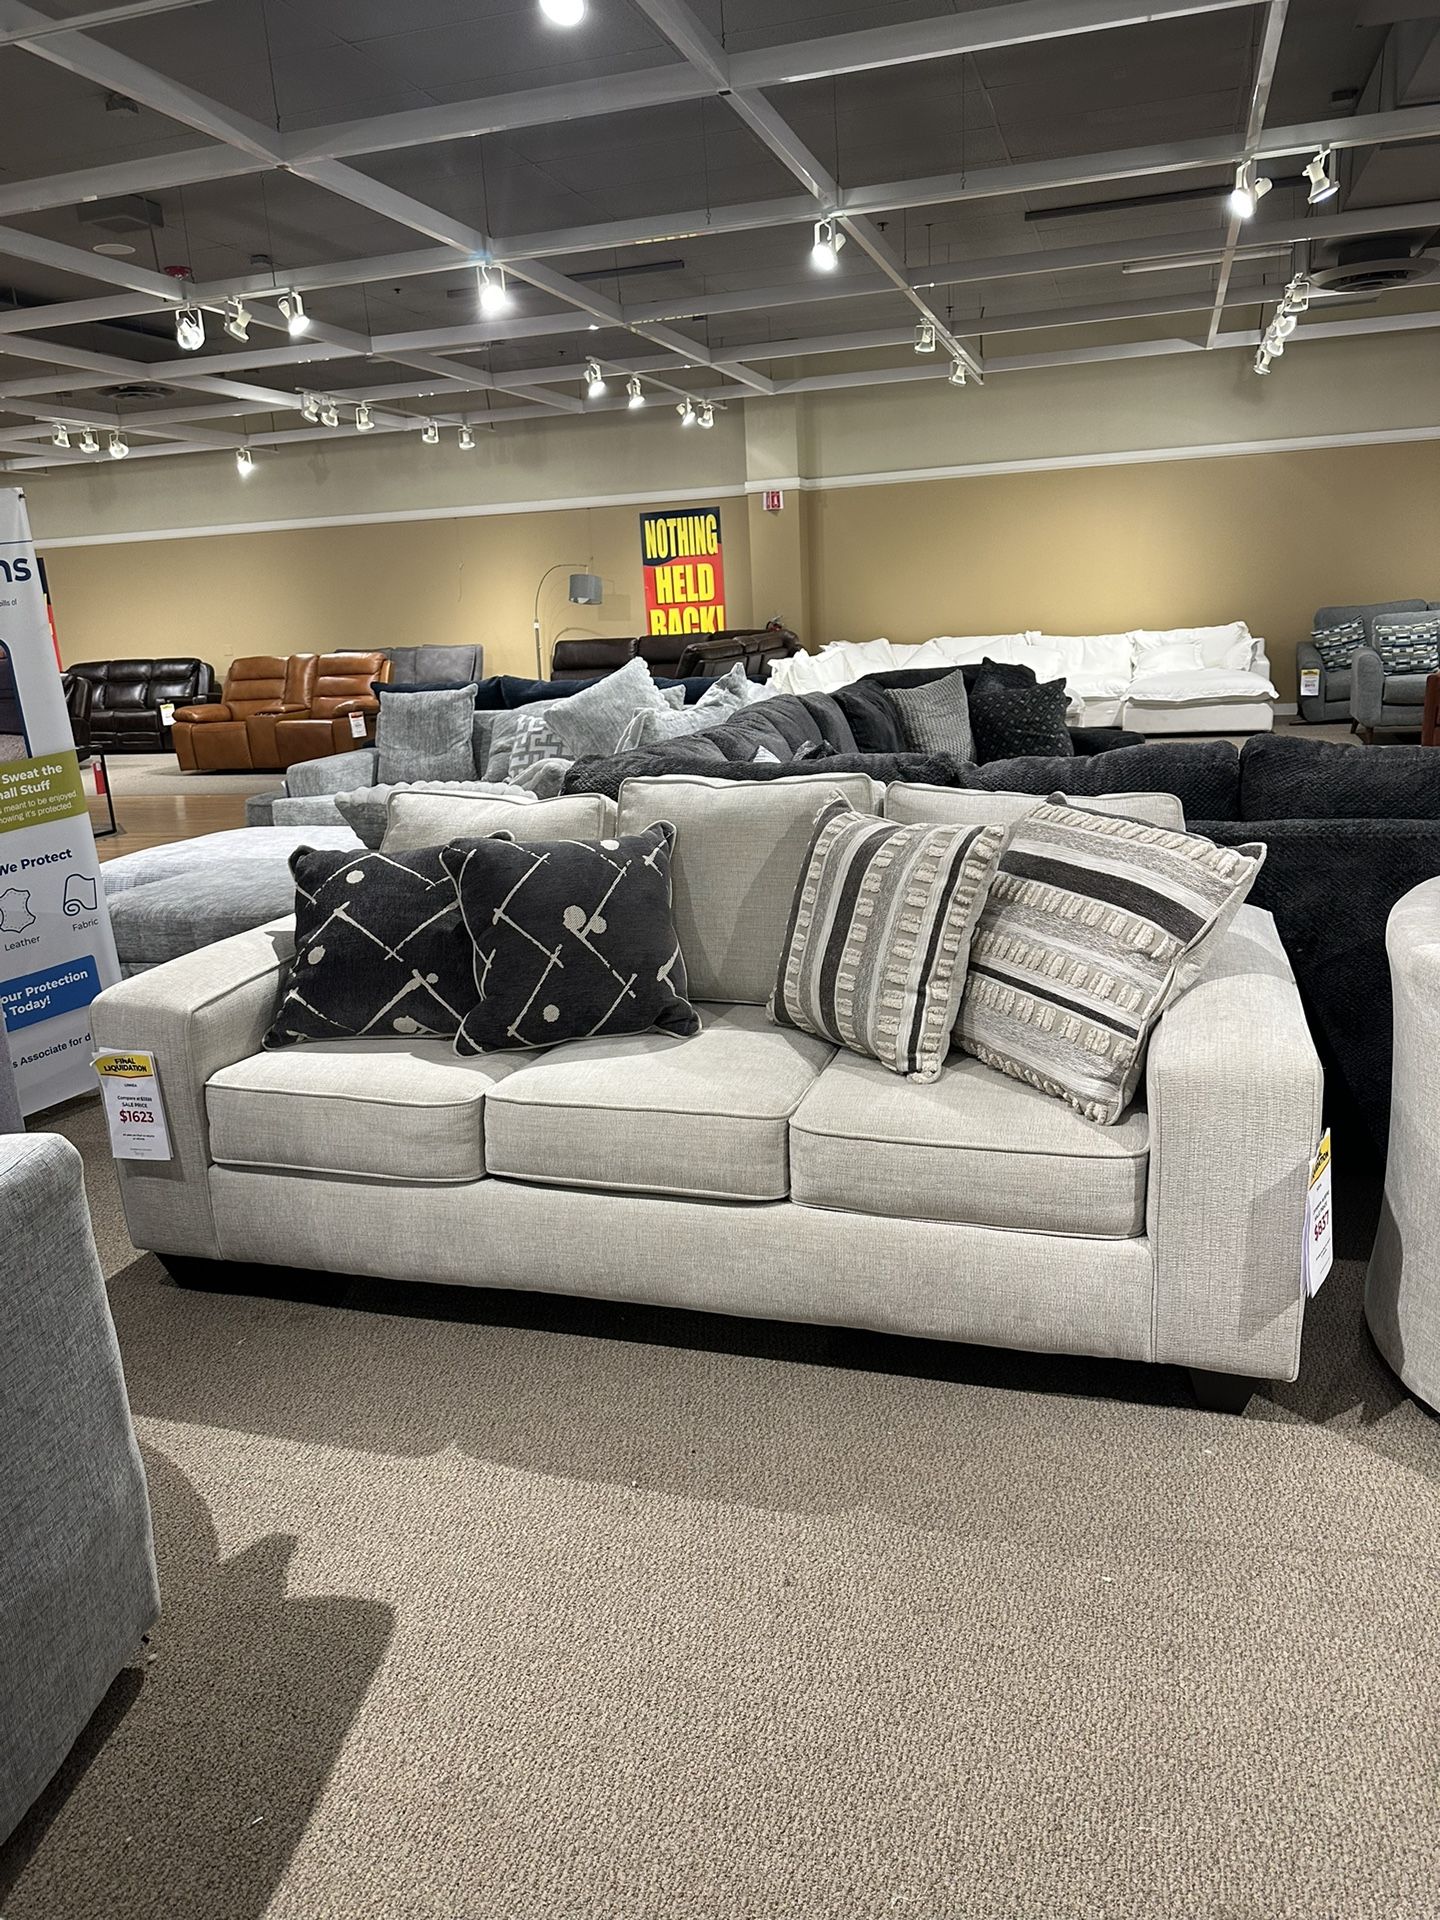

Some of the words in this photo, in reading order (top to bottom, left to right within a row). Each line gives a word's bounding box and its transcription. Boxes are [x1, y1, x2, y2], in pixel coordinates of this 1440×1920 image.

[644, 514, 718, 559] NOTHING
[654, 563, 715, 604] HELD
[650, 605, 724, 636] BACK!
[2, 768, 39, 784] Sweat
[41, 765, 63, 776] the
[20, 780, 50, 795] Stuff
[4, 801, 27, 813] meant
[28, 800, 36, 808] to
[48, 790, 77, 804] enjoyed
[25, 810, 36, 818] it's
[38, 802, 72, 816] protected
[0, 863, 17, 876] We
[21, 849, 72, 870] Protect
[72, 919, 99, 931] Fabric
[4, 936, 40, 951] Leather
[25, 970, 88, 997] Protection
[9, 996, 51, 1016] Today!
[20, 1042, 68, 1066] Associate
[69, 1037, 82, 1048] for
[104, 1064, 147, 1072] LIQUIDATION
[119, 1109, 155, 1124] $1623
